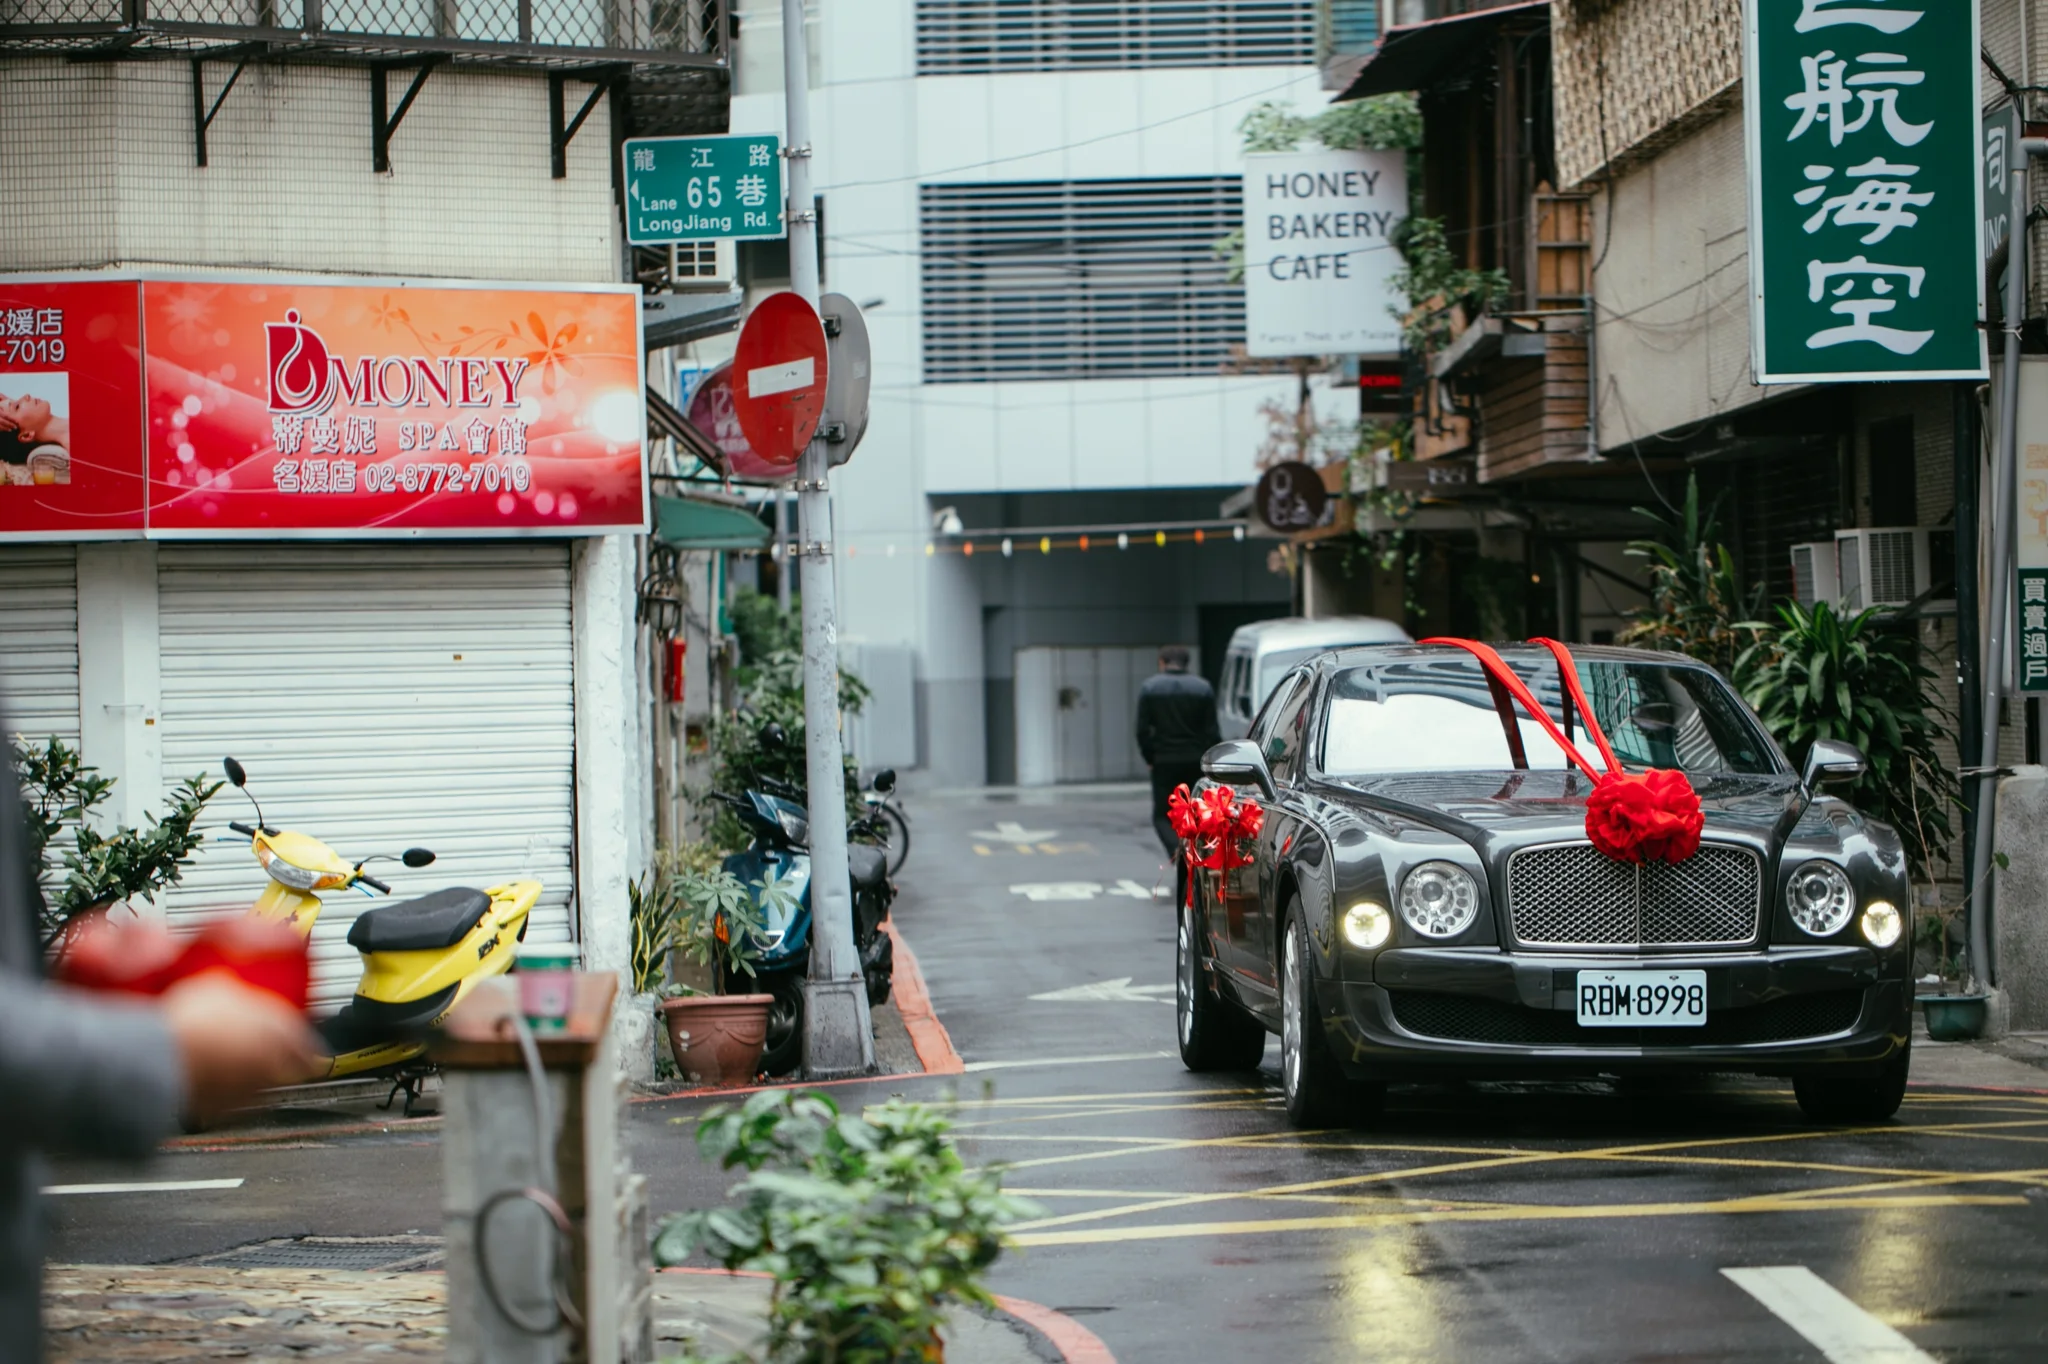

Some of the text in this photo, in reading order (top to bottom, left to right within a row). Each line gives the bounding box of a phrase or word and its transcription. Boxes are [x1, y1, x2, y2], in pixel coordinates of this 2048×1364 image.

[633, 144, 771, 171] 龍江路
[641, 174, 767, 211] Lane 65 巷
[1267, 171, 1380, 198] HONEY
[639, 212, 771, 233] LongJiang Rd.
[1268, 212, 1392, 240] BAKERY
[1269, 253, 1350, 280] CAFE
[272, 415, 376, 454] 蒂曼妮
[273, 459, 530, 493] 名媛店 02-8772-7019
[2023, 578, 2048, 686] 買賣過戶
